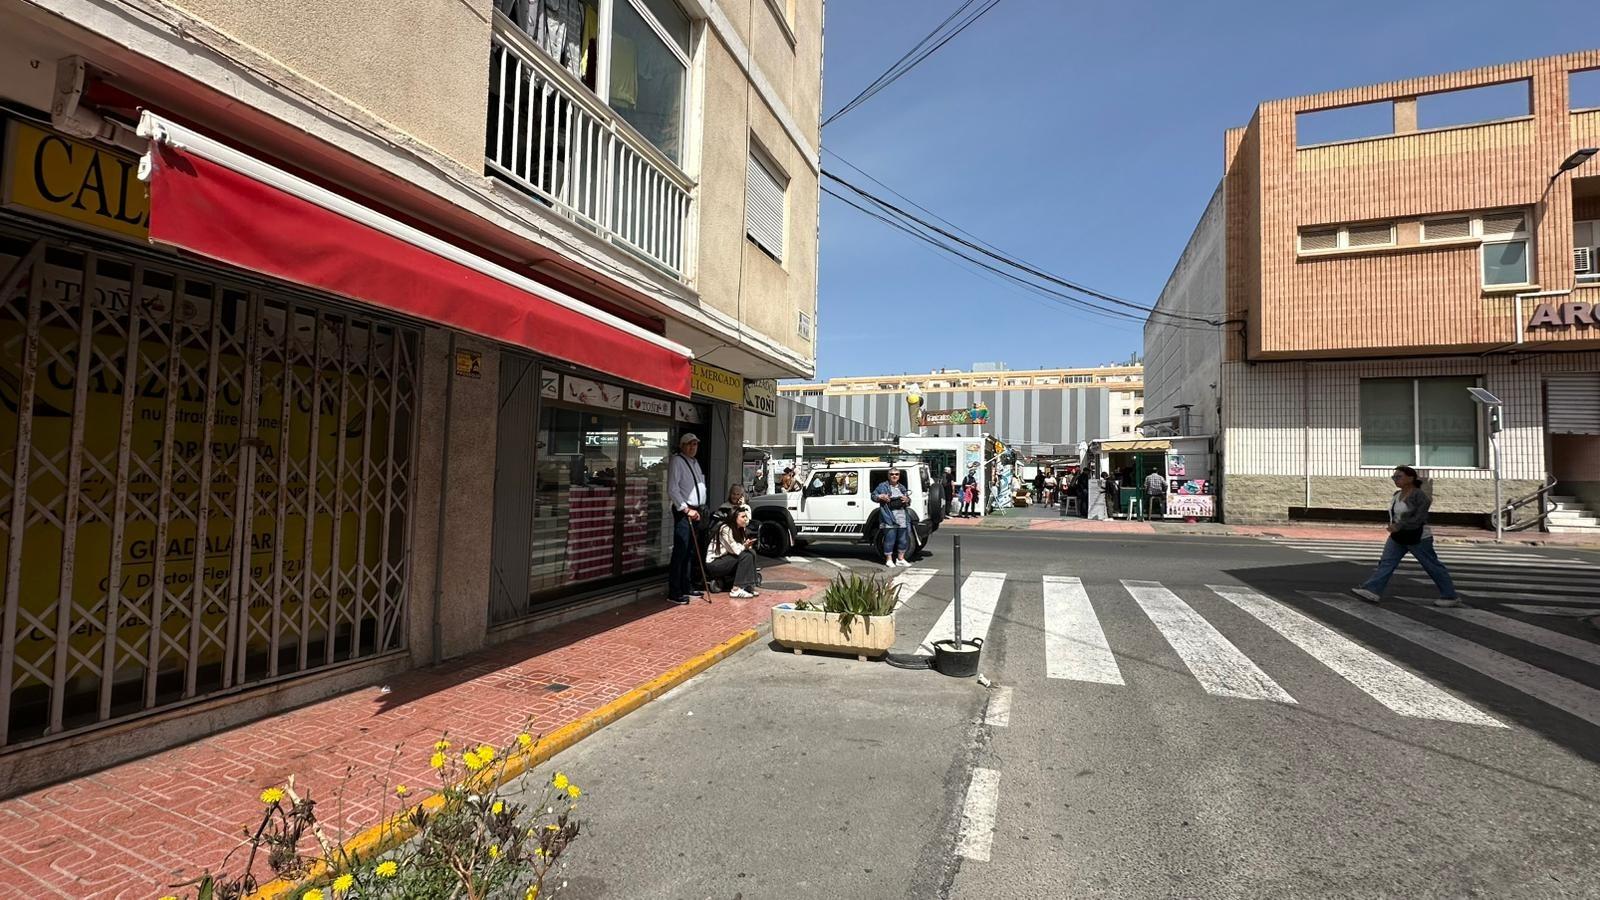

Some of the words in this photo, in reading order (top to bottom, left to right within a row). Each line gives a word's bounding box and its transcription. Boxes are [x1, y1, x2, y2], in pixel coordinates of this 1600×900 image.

[34, 136, 151, 230] CAL
[1530, 302, 1600, 326] AR
[700, 367, 740, 388] MERCADO
[754, 394, 775, 413] TOÑI
